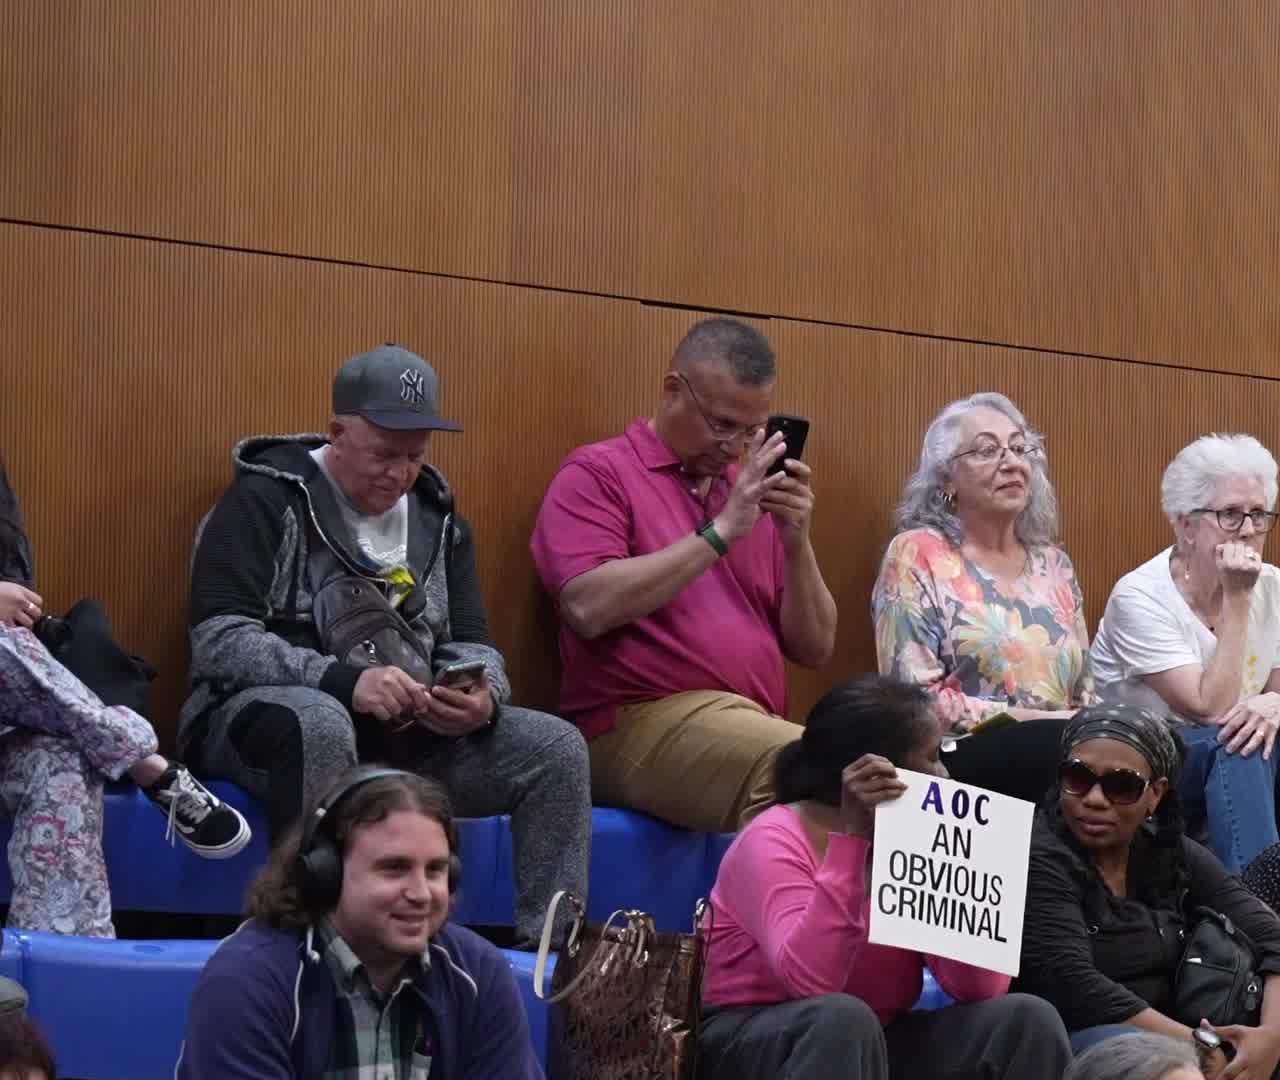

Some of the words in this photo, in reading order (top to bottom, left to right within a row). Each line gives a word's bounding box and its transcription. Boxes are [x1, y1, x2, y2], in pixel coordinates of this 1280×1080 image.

[921, 781, 990, 825] AOC
[931, 823, 972, 859] AN
[889, 850, 1003, 906] OBVIOUS
[877, 883, 1008, 943] CRIMINAL
